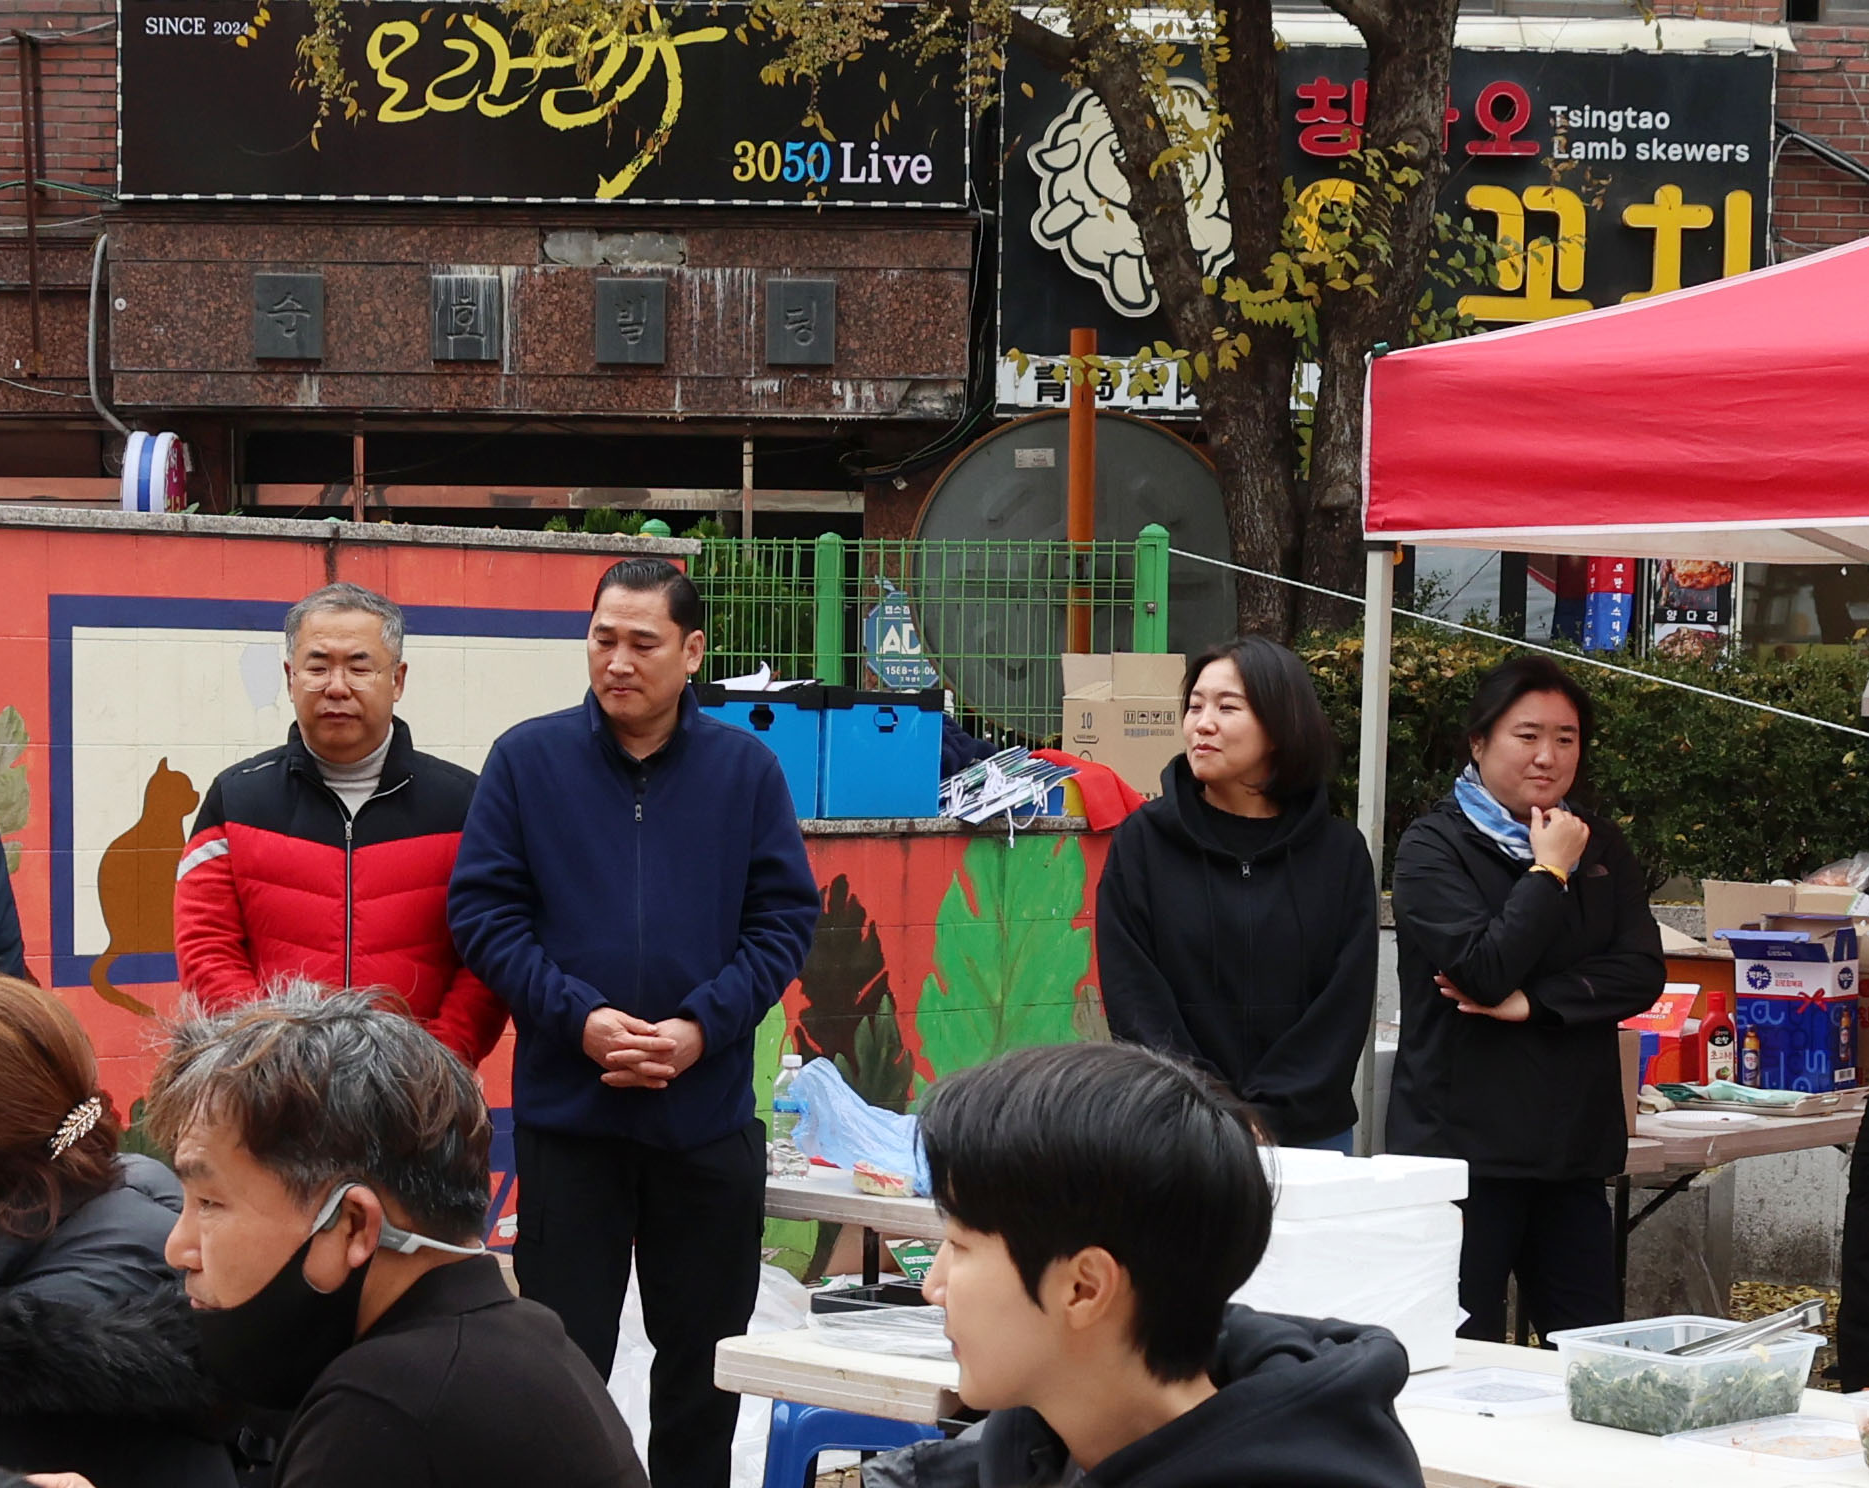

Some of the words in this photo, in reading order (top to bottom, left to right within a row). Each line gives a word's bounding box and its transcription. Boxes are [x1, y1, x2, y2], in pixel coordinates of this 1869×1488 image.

[145, 17, 206, 35] SINCE
[213, 21, 249, 35] 2024
[1295, 76, 1541, 157] 칭오
[1549, 105, 1671, 136] Tsingtao
[1552, 137, 1628, 161] Lamb
[1635, 137, 1750, 162] skewers
[732, 140, 831, 183] 3050
[839, 141, 933, 185] Live
[1666, 610, 1718, 622] 양다리
[1081, 711, 1093, 730] 10
